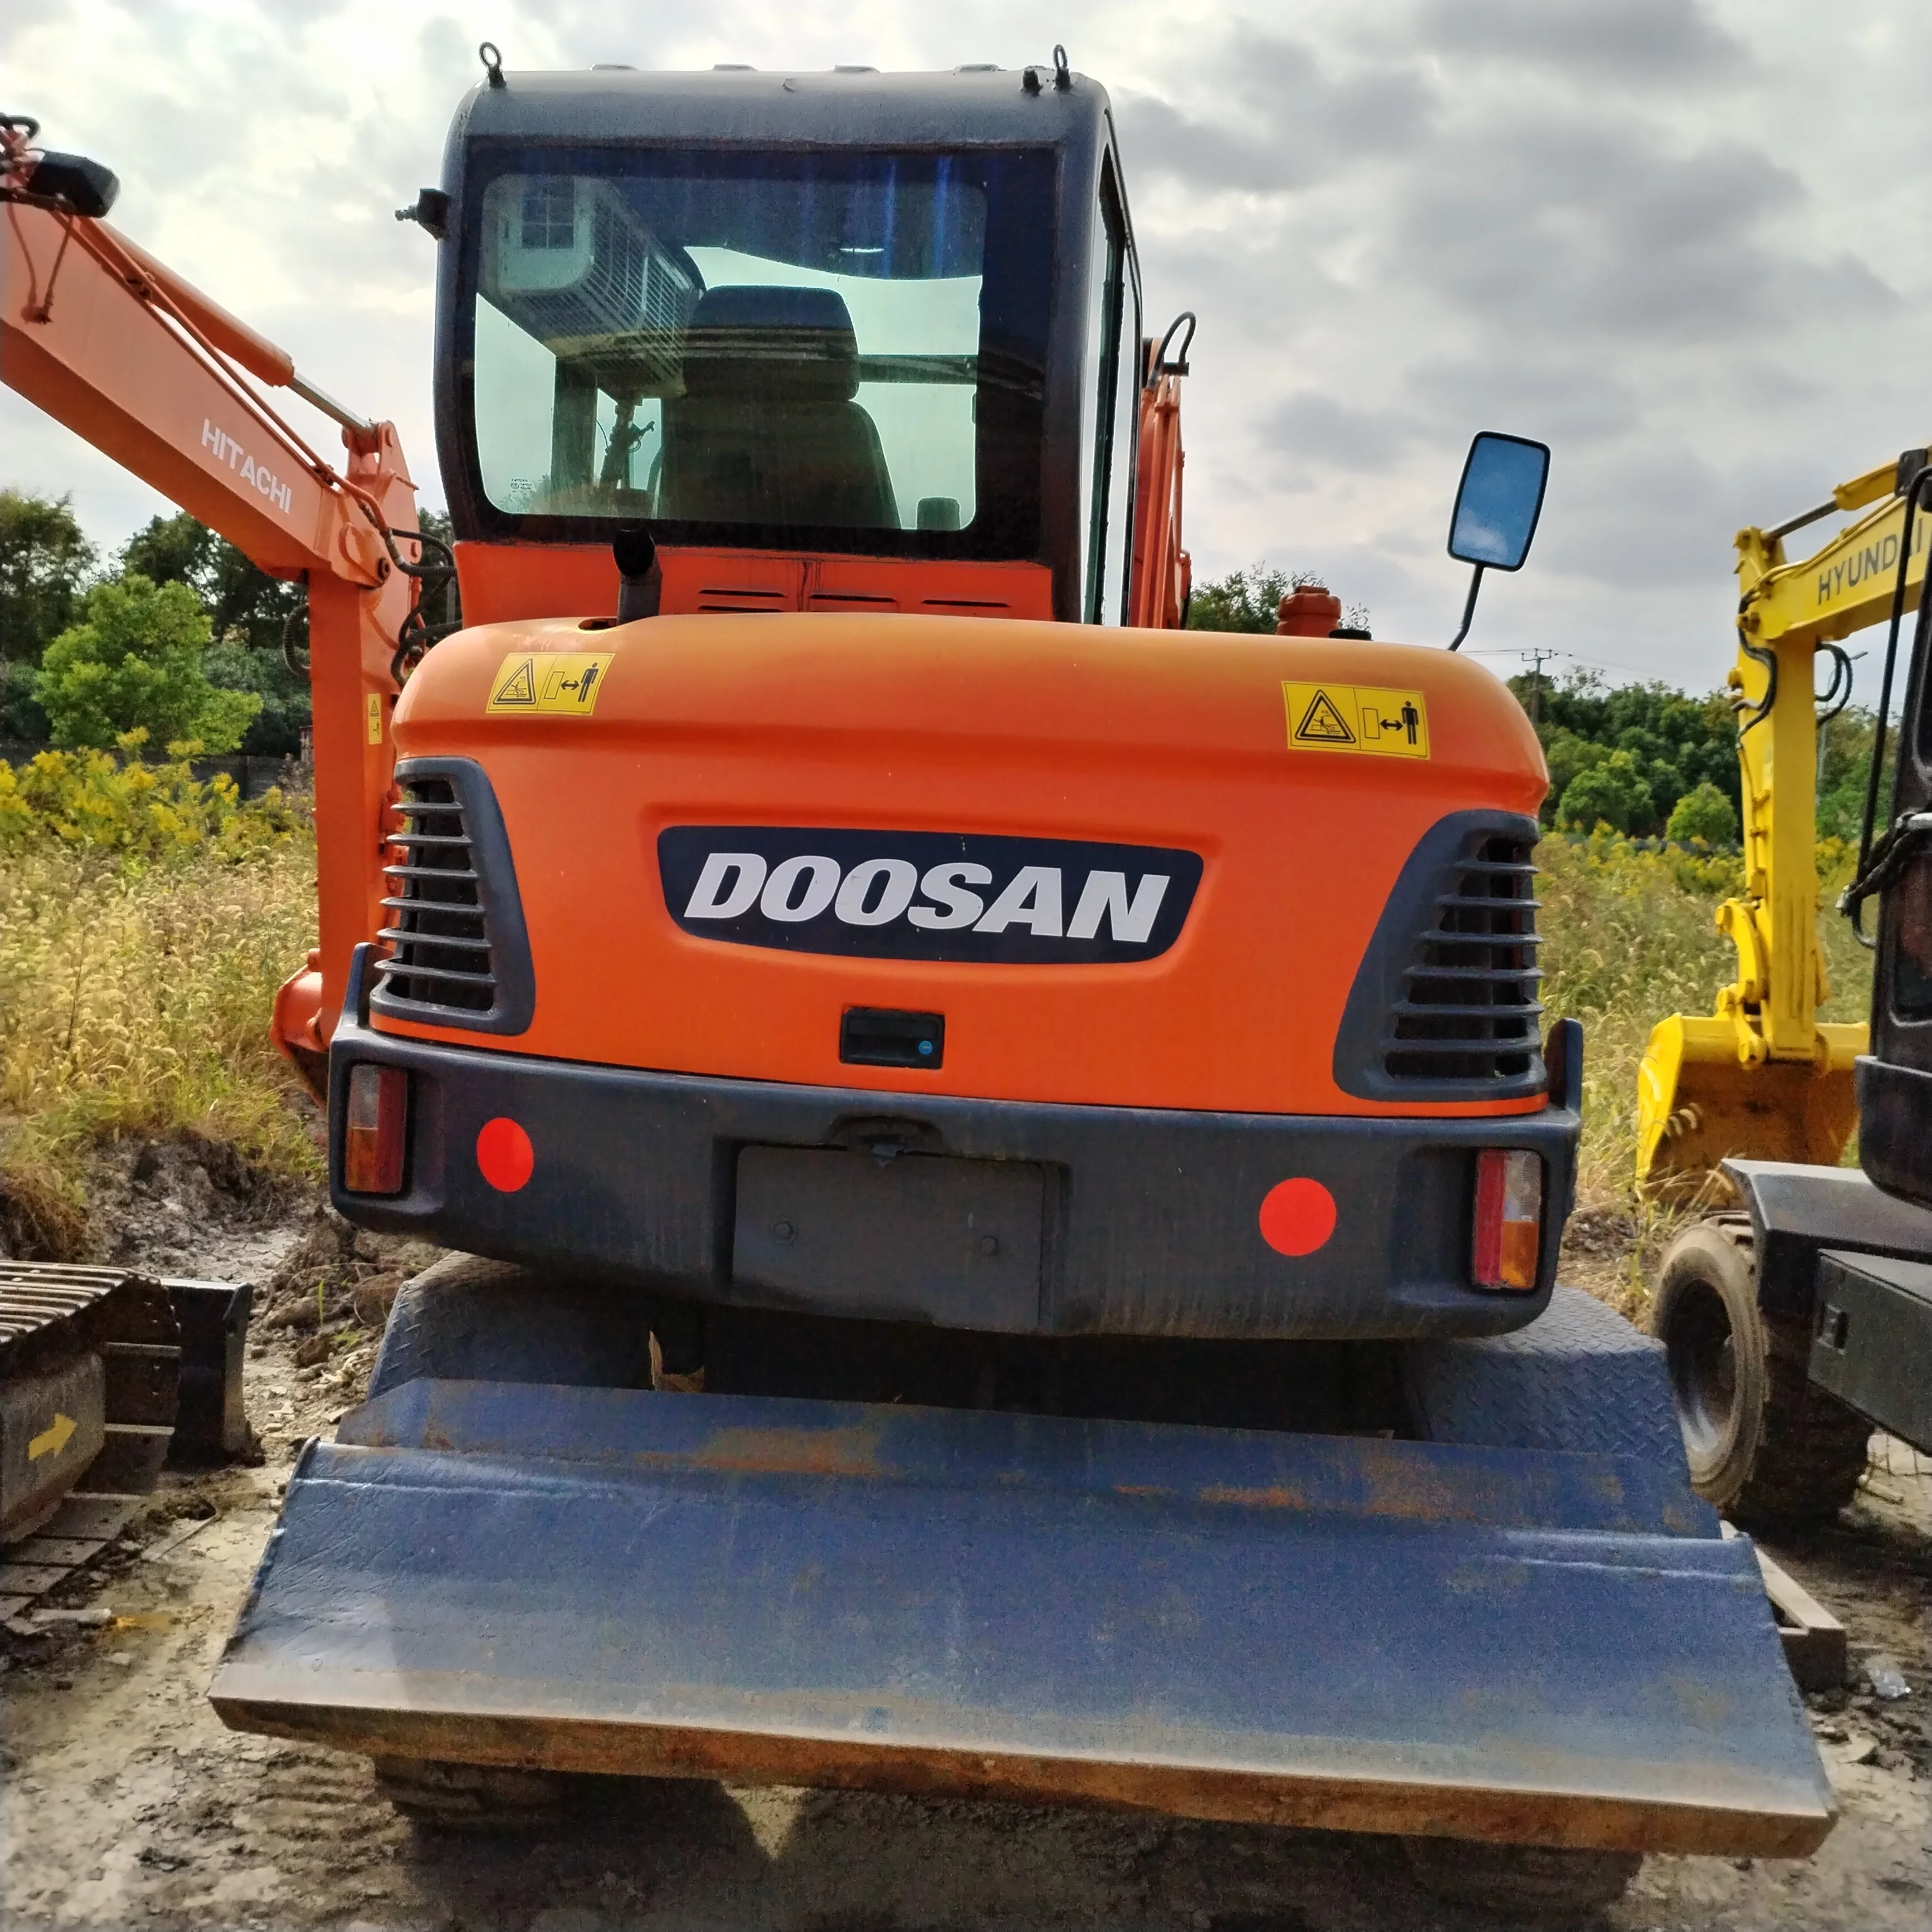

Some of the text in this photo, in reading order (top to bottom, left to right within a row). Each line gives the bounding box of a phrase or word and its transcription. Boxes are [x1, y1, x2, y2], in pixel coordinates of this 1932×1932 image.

[201, 418, 292, 514] HITACHI
[1818, 518, 1923, 606] HYUNDI
[684, 852, 1170, 943] DOOSAN
